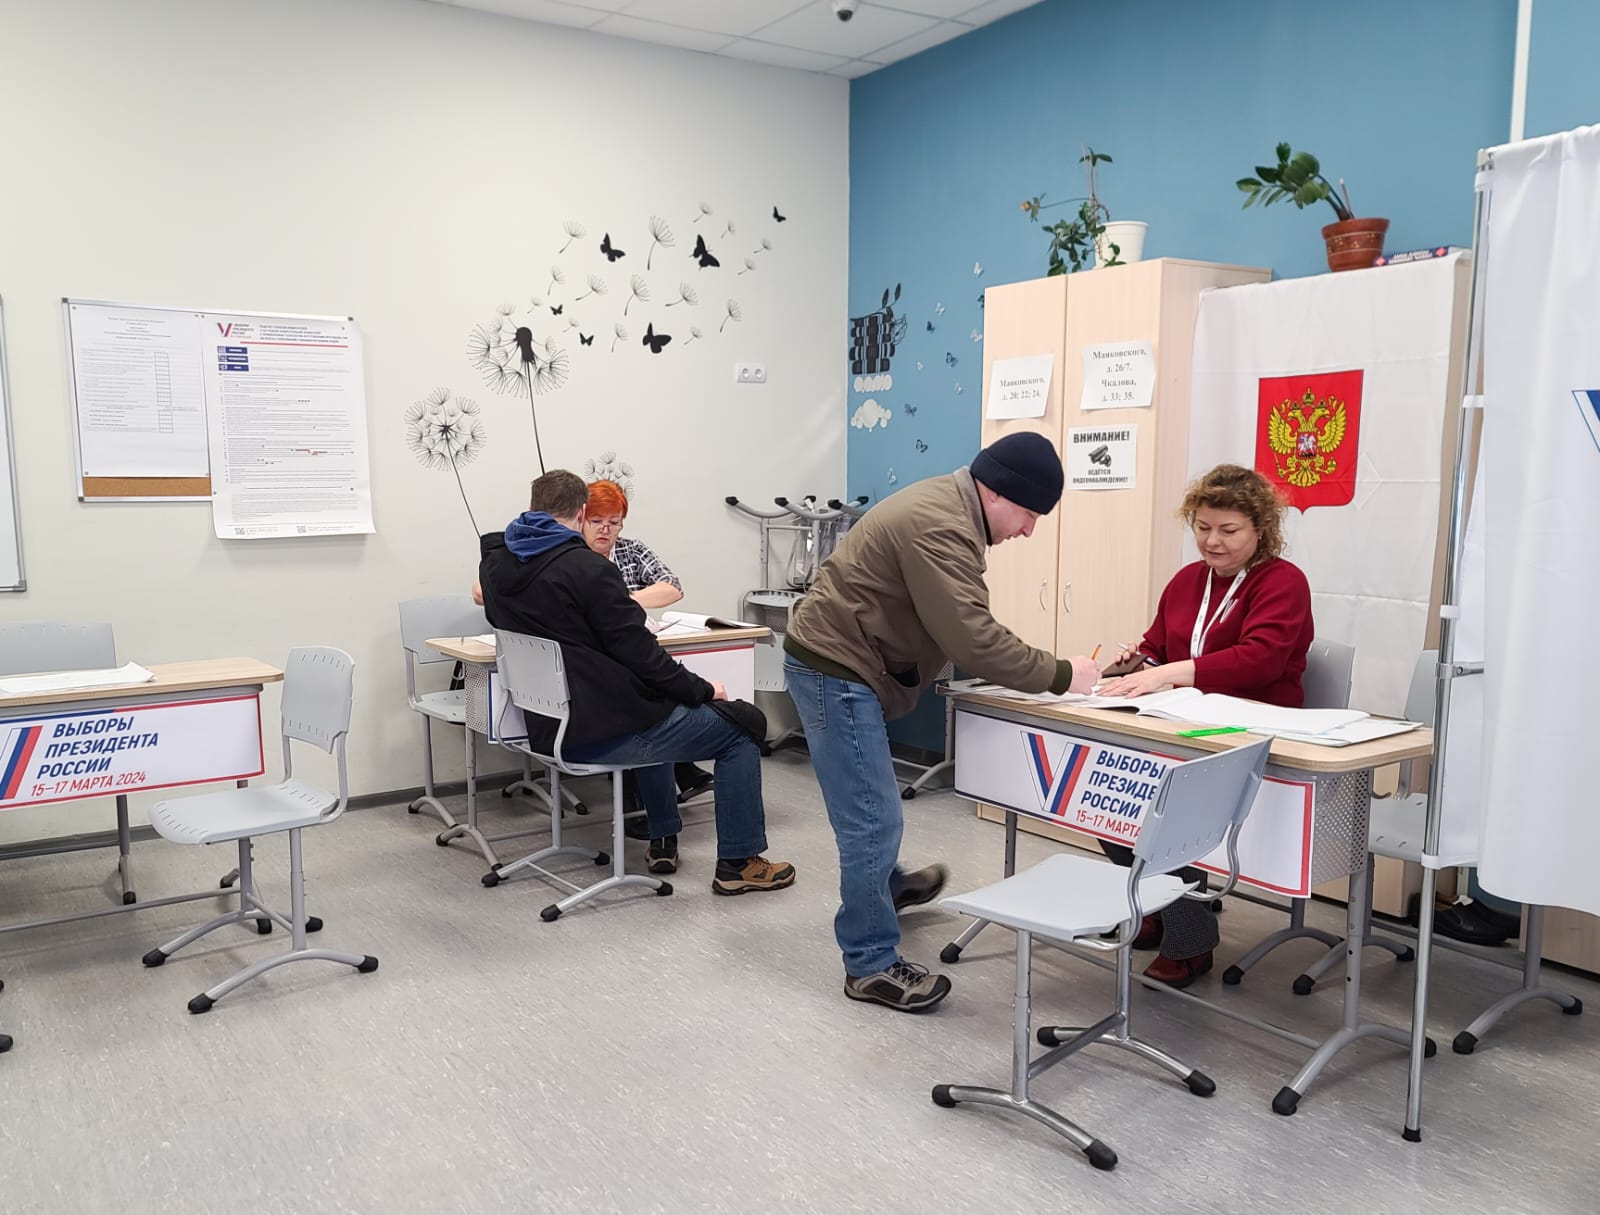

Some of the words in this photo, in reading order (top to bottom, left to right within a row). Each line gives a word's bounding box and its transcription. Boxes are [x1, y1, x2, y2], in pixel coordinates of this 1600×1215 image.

[1073, 431, 1130, 443] ВНИМАНИЕ!
[52, 716, 134, 738] ВЫБОРЫ
[45, 733, 159, 759] ПРЕЗИДЕНТА
[37, 757, 112, 779] РОССИИ
[1096, 750, 1167, 780] ВЫБОРЫ
[69, 775, 113, 792] МАРТА
[115, 771, 146, 786] 2024
[1088, 770, 1158, 801] ПРЕЗИДЕ
[1080, 790, 1142, 819] РОССИИ
